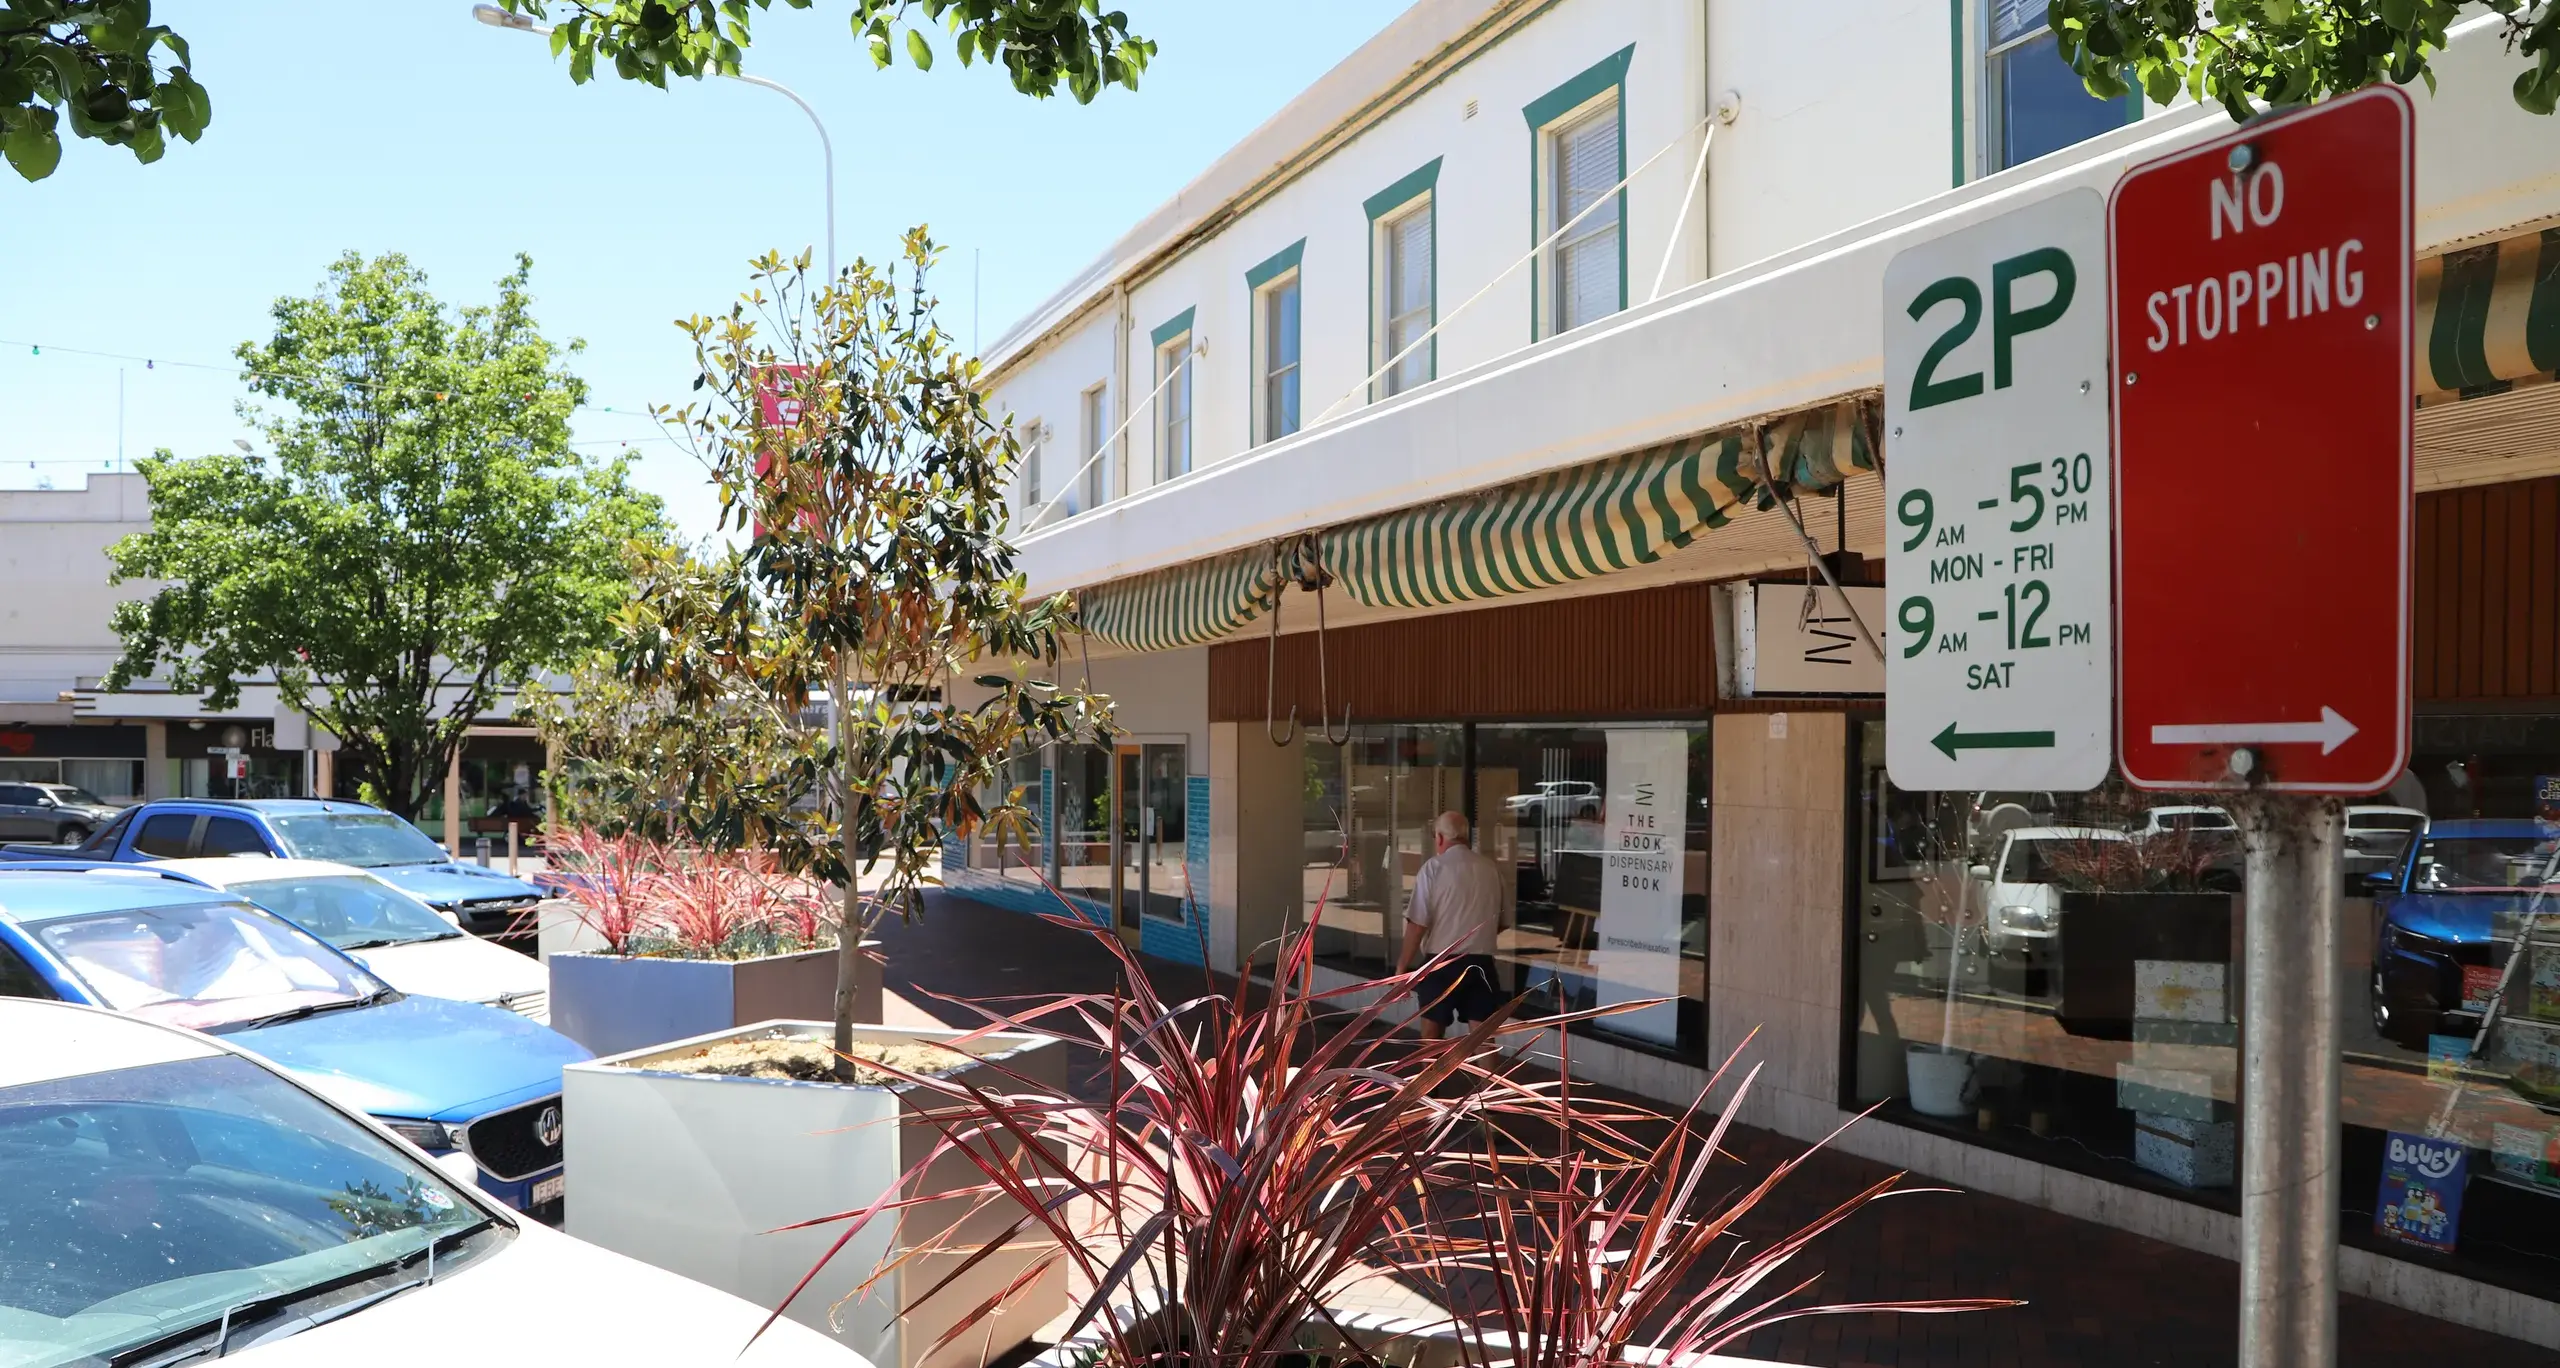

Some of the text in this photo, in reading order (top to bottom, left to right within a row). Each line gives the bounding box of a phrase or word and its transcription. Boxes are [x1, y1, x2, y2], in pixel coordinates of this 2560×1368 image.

[2210, 162, 2285, 240] NO
[2146, 240, 2364, 352] STOPPING
[1906, 247, 2076, 411] 2P
[1930, 554, 1983, 584] MON
[2013, 543, 2054, 573] FRI
[1966, 662, 2016, 690] SAT
[1628, 813, 1655, 828] THE
[1623, 834, 1661, 851] BOOK
[1610, 855, 1674, 874] DISPENSARY
[1622, 874, 1661, 892] BOOK
[2389, 1138, 2461, 1178] BLUEY
